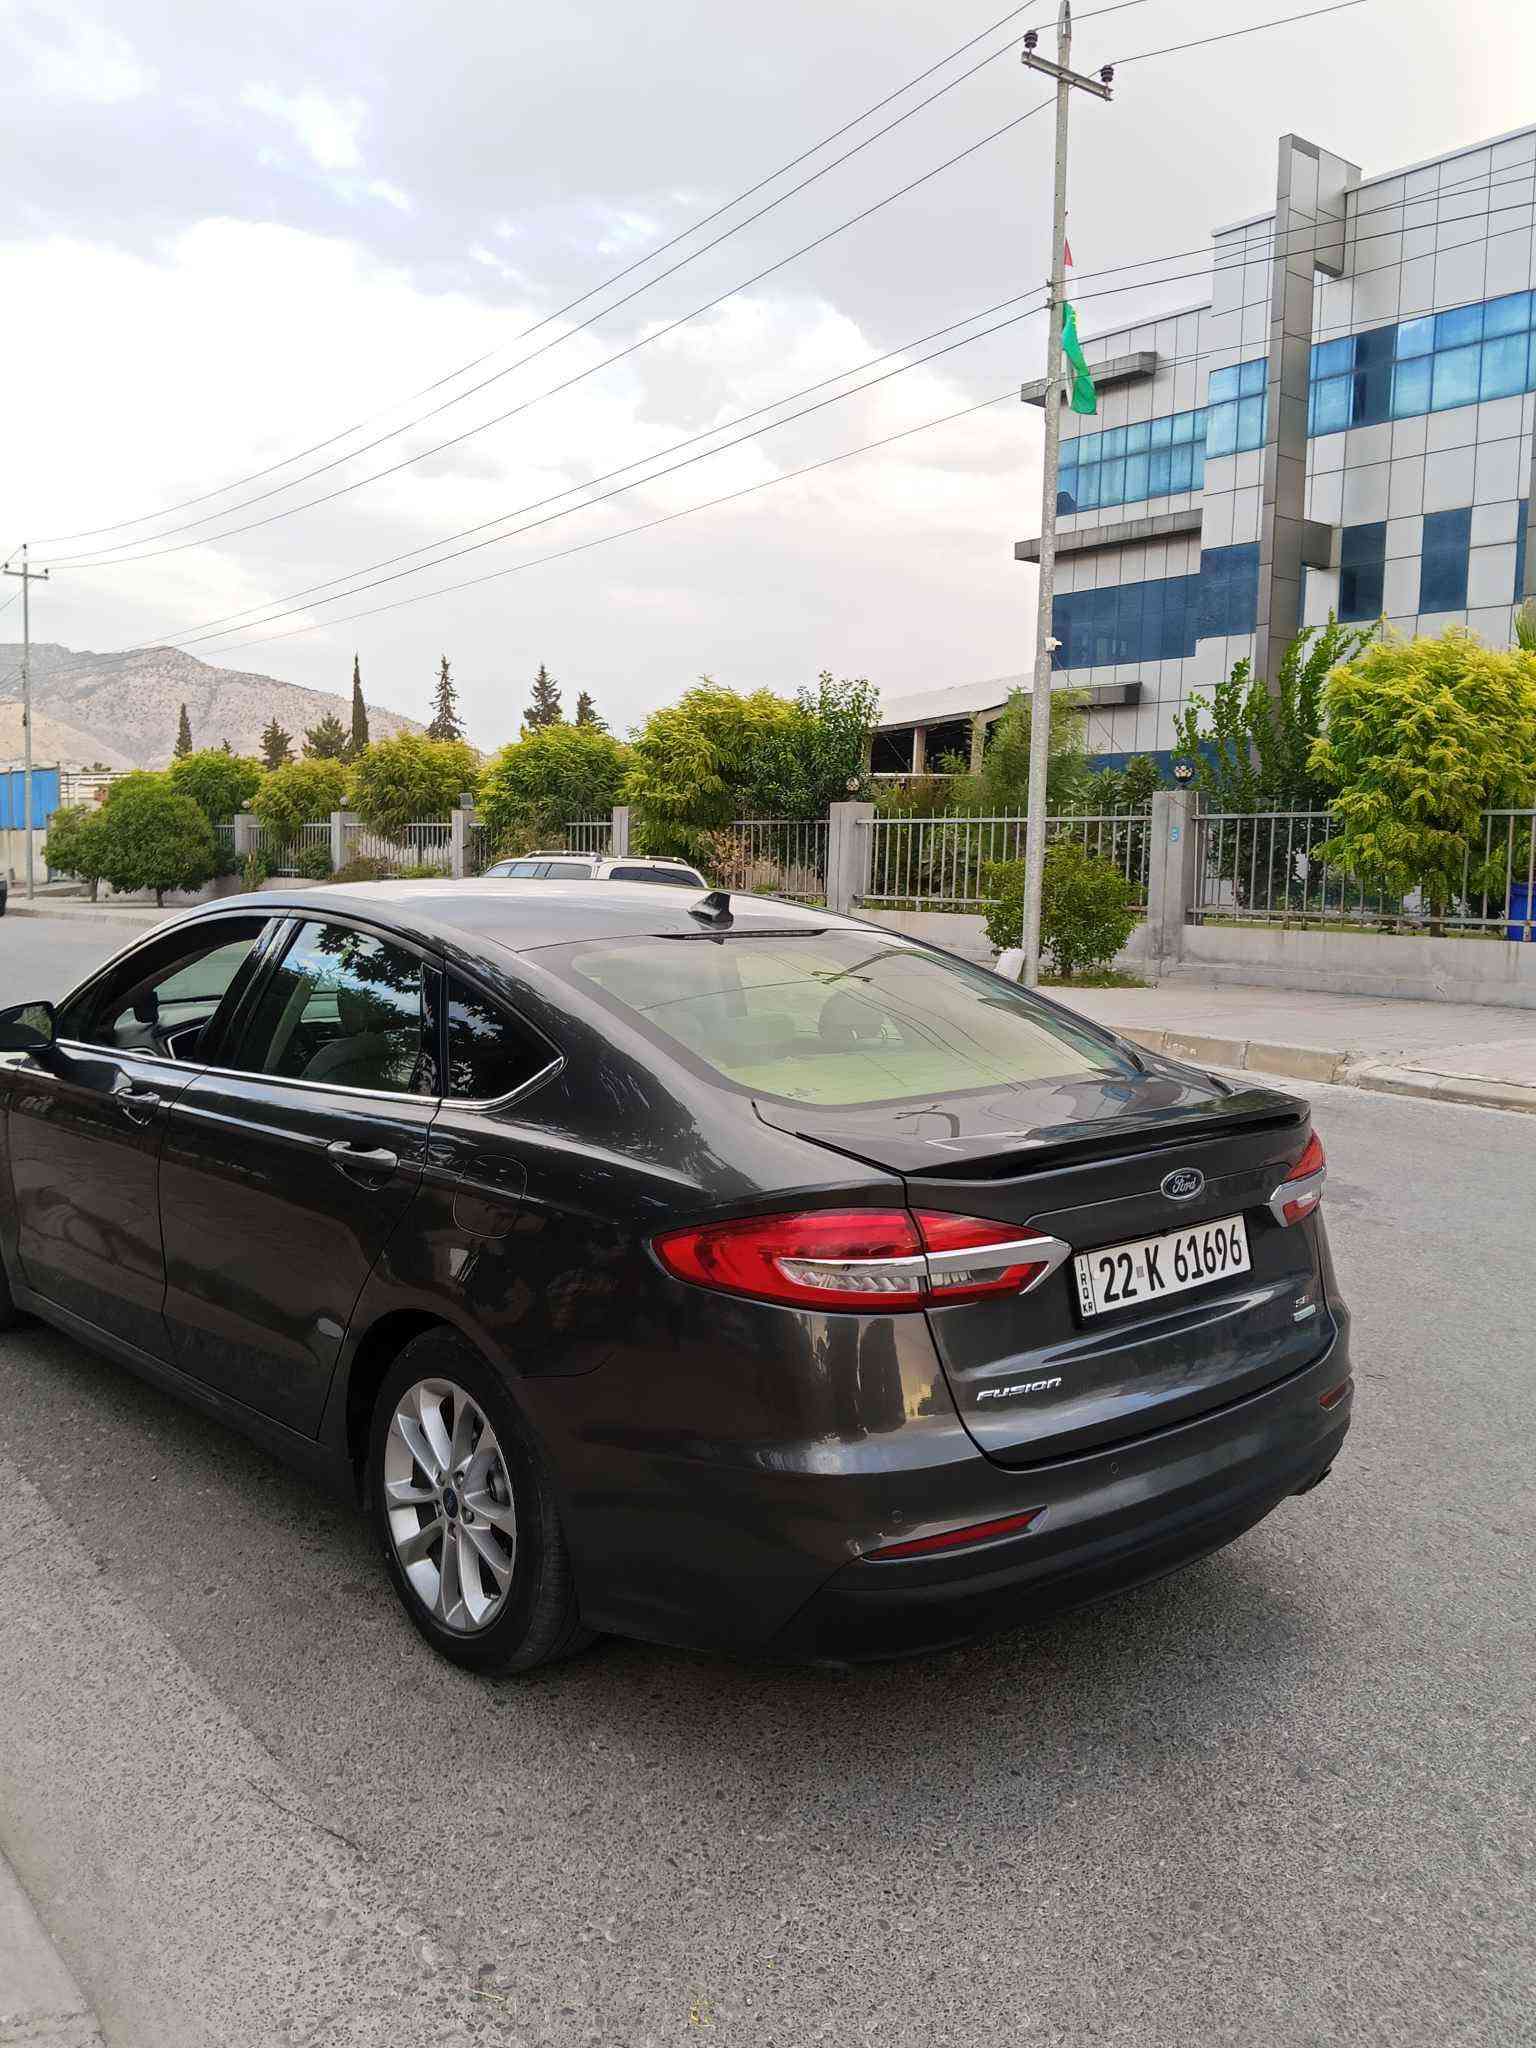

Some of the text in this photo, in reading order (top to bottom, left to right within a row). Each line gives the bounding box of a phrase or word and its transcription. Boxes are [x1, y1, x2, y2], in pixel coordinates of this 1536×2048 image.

[1172, 1174, 1197, 1193] Ford
[1100, 1224, 1242, 1304] 22 K 61696
